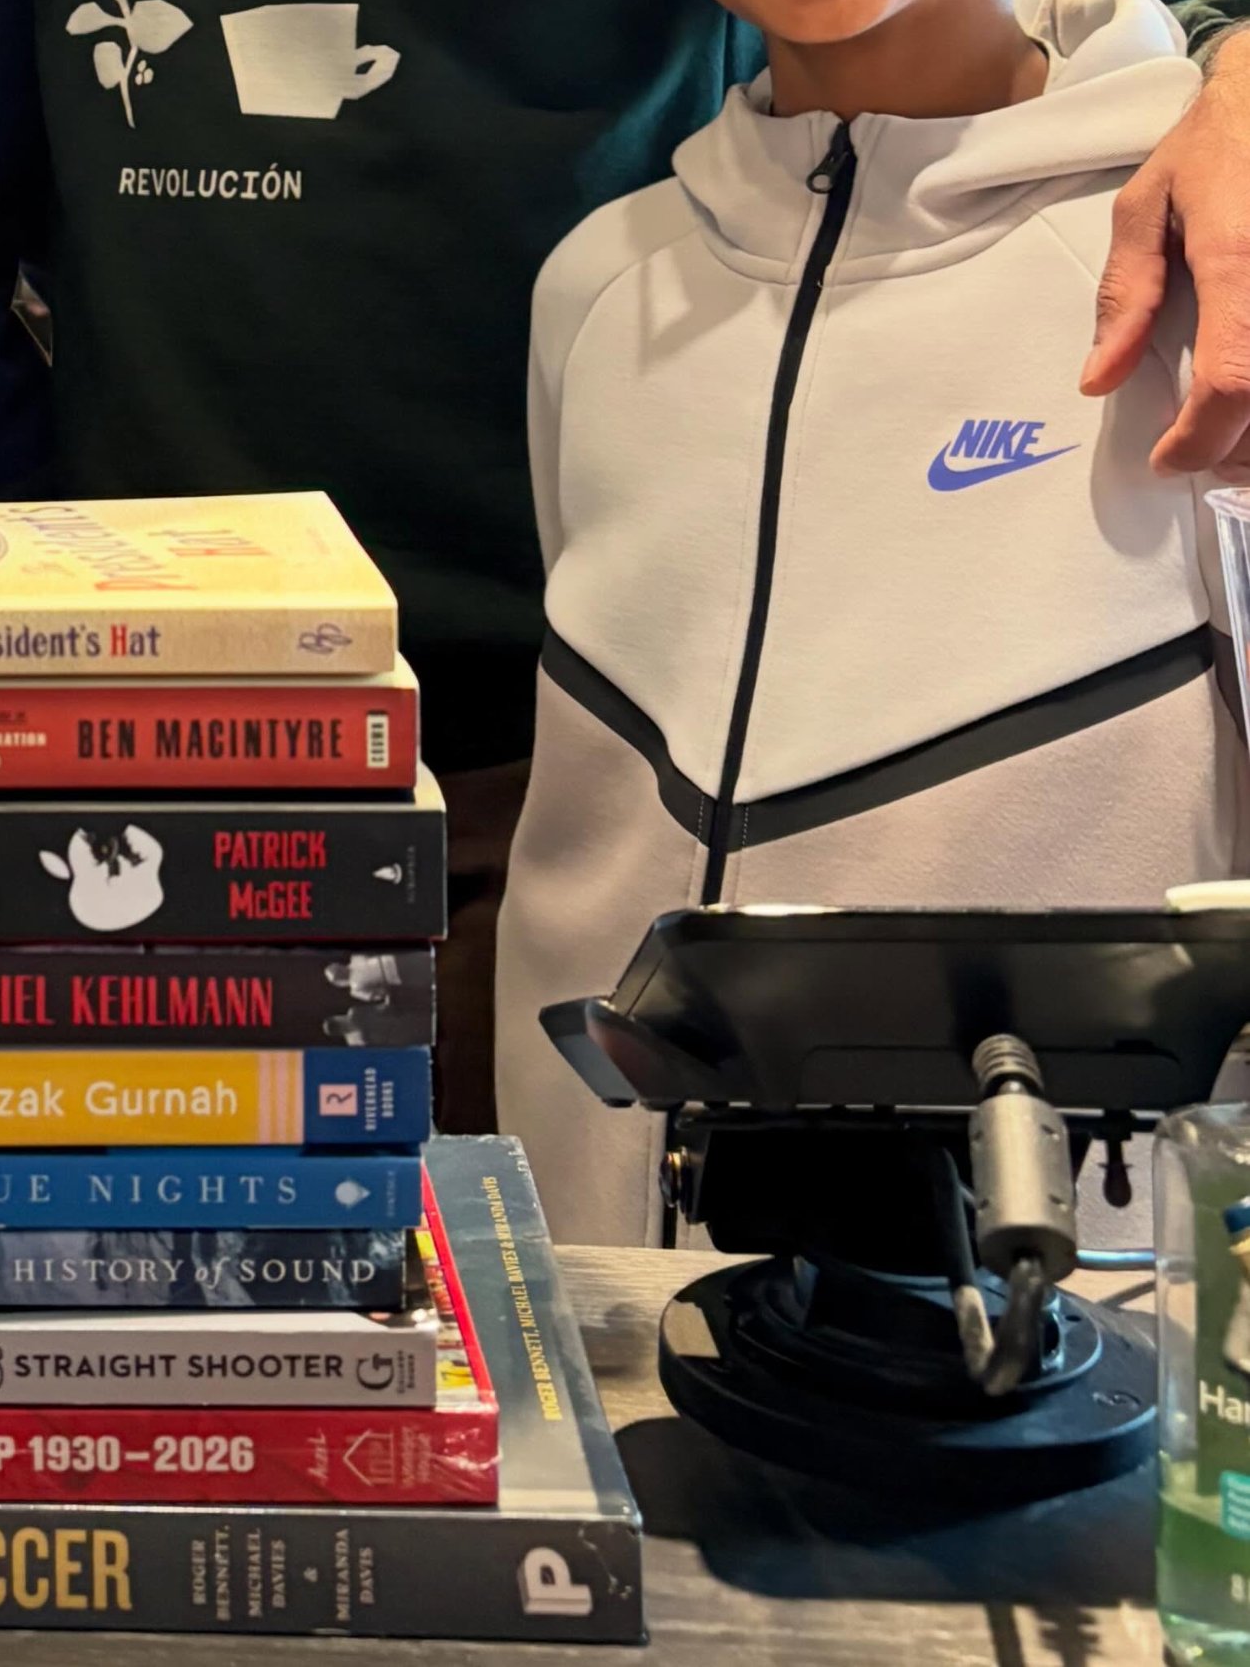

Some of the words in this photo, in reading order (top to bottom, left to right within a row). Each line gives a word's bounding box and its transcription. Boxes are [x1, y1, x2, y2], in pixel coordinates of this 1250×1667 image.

[119, 162, 302, 200] REVOLUCIÓN
[950, 419, 1046, 460] NIKE
[110, 624, 161, 657] Hat
[78, 719, 136, 759] BEN
[156, 719, 343, 759] MACINTYRE
[214, 830, 327, 869] PATRICK
[229, 881, 312, 920] McGEE
[71, 975, 273, 1027] KEHLMANN
[85, 1080, 239, 1116] Gurnah
[364, 1067, 377, 1131] RIVERHEAD
[381, 1081, 394, 1118] BOOKS
[89, 1175, 297, 1204] NIGHTS
[488, 1200, 512, 1240] MIRANDA
[14, 1258, 184, 1282] HISTORY
[194, 1257, 229, 1290] of
[240, 1258, 377, 1283] SOUND
[502, 1250, 524, 1282] DAVIES
[511, 1283, 537, 1327] MICHAEL
[15, 1354, 177, 1378] STRAIGHT
[188, 1354, 344, 1378] SHOOTER
[523, 1329, 552, 1380] BENNETT,
[536, 1382, 563, 1421] ROGER
[192, 1540, 206, 1604] ROGER
[248, 1528, 262, 1617] MICHAEL
[271, 1539, 286, 1608] DAVIES
[336, 1529, 351, 1621] MIRANDA
[360, 1547, 375, 1604] DAVIS
